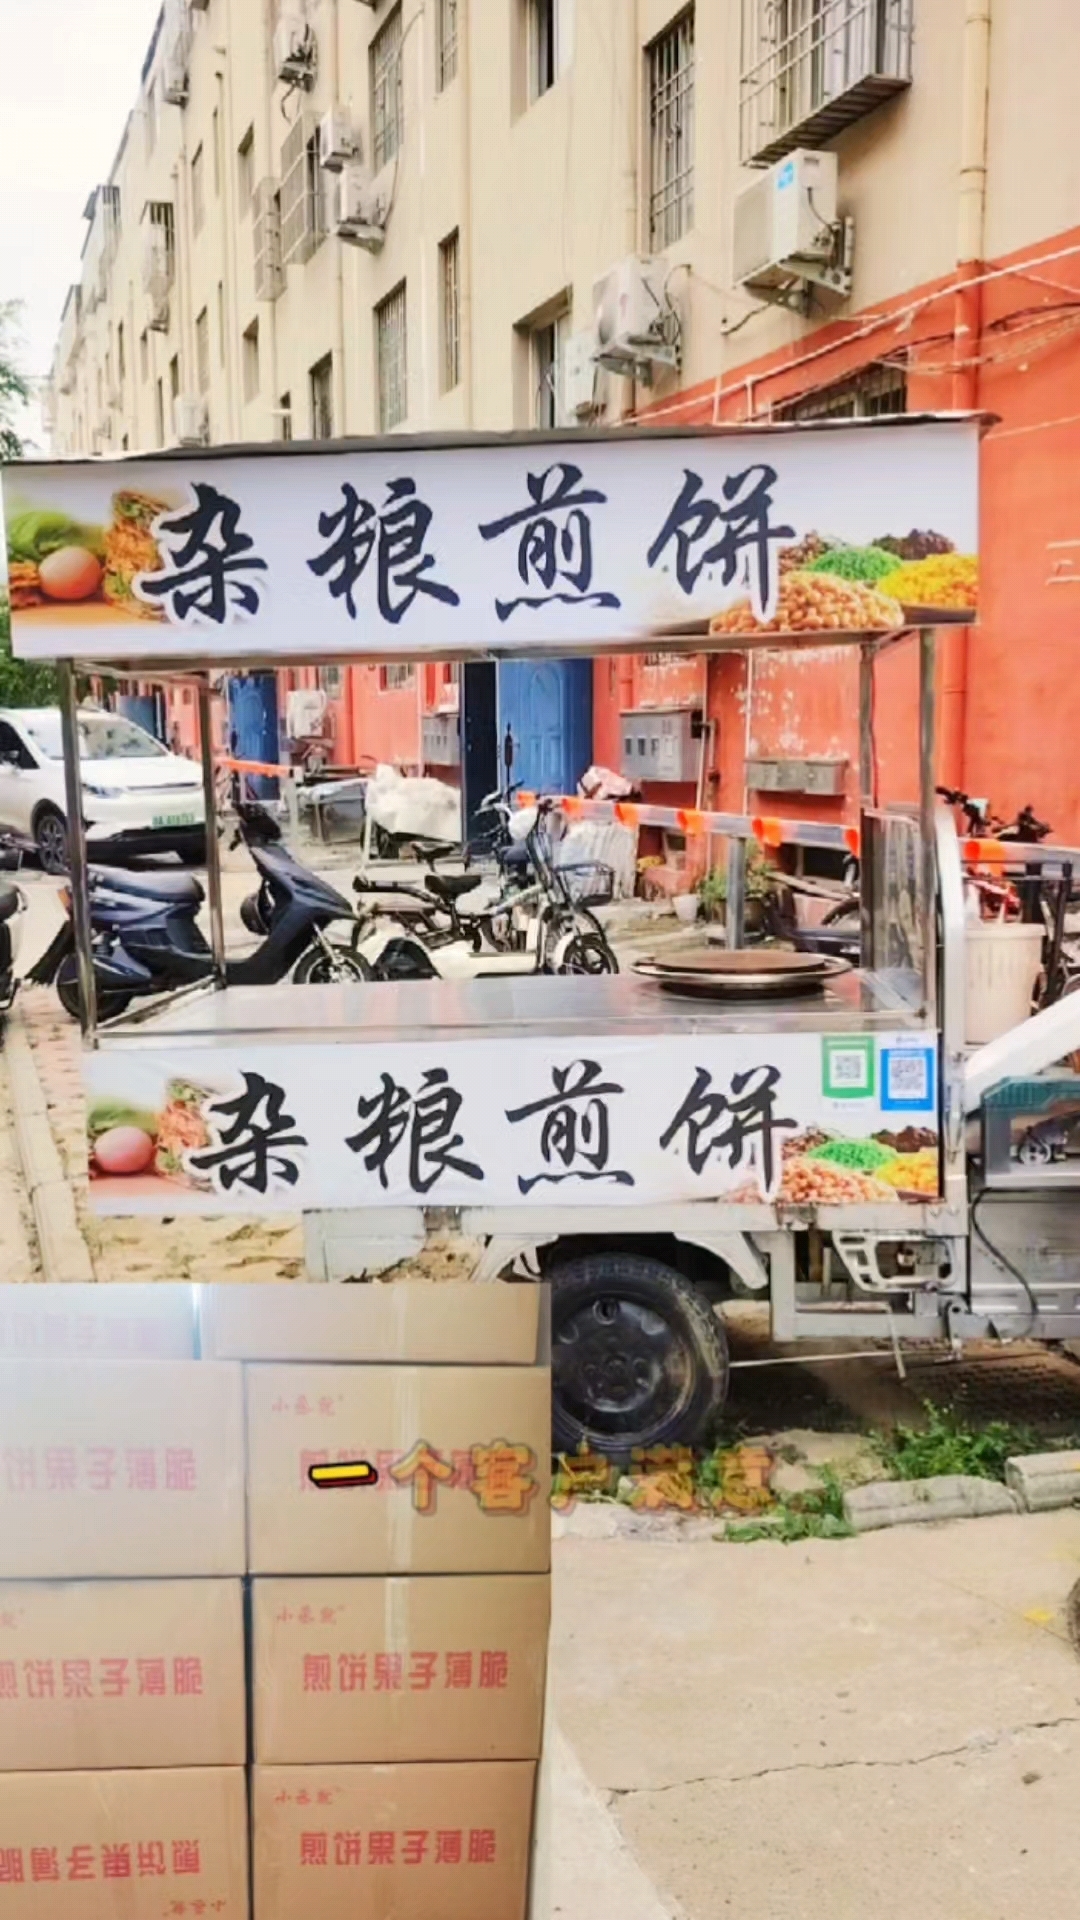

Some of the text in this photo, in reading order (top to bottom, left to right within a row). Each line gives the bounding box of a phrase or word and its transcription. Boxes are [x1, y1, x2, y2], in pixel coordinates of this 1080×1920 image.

[142, 464, 797, 624] 杂粮煎饼
[193, 1059, 799, 1196] 杂粮煎饼
[303, 1651, 508, 1692] 煎饼果子薄脆
[301, 1829, 496, 1866] 煎饼果子薄脆
